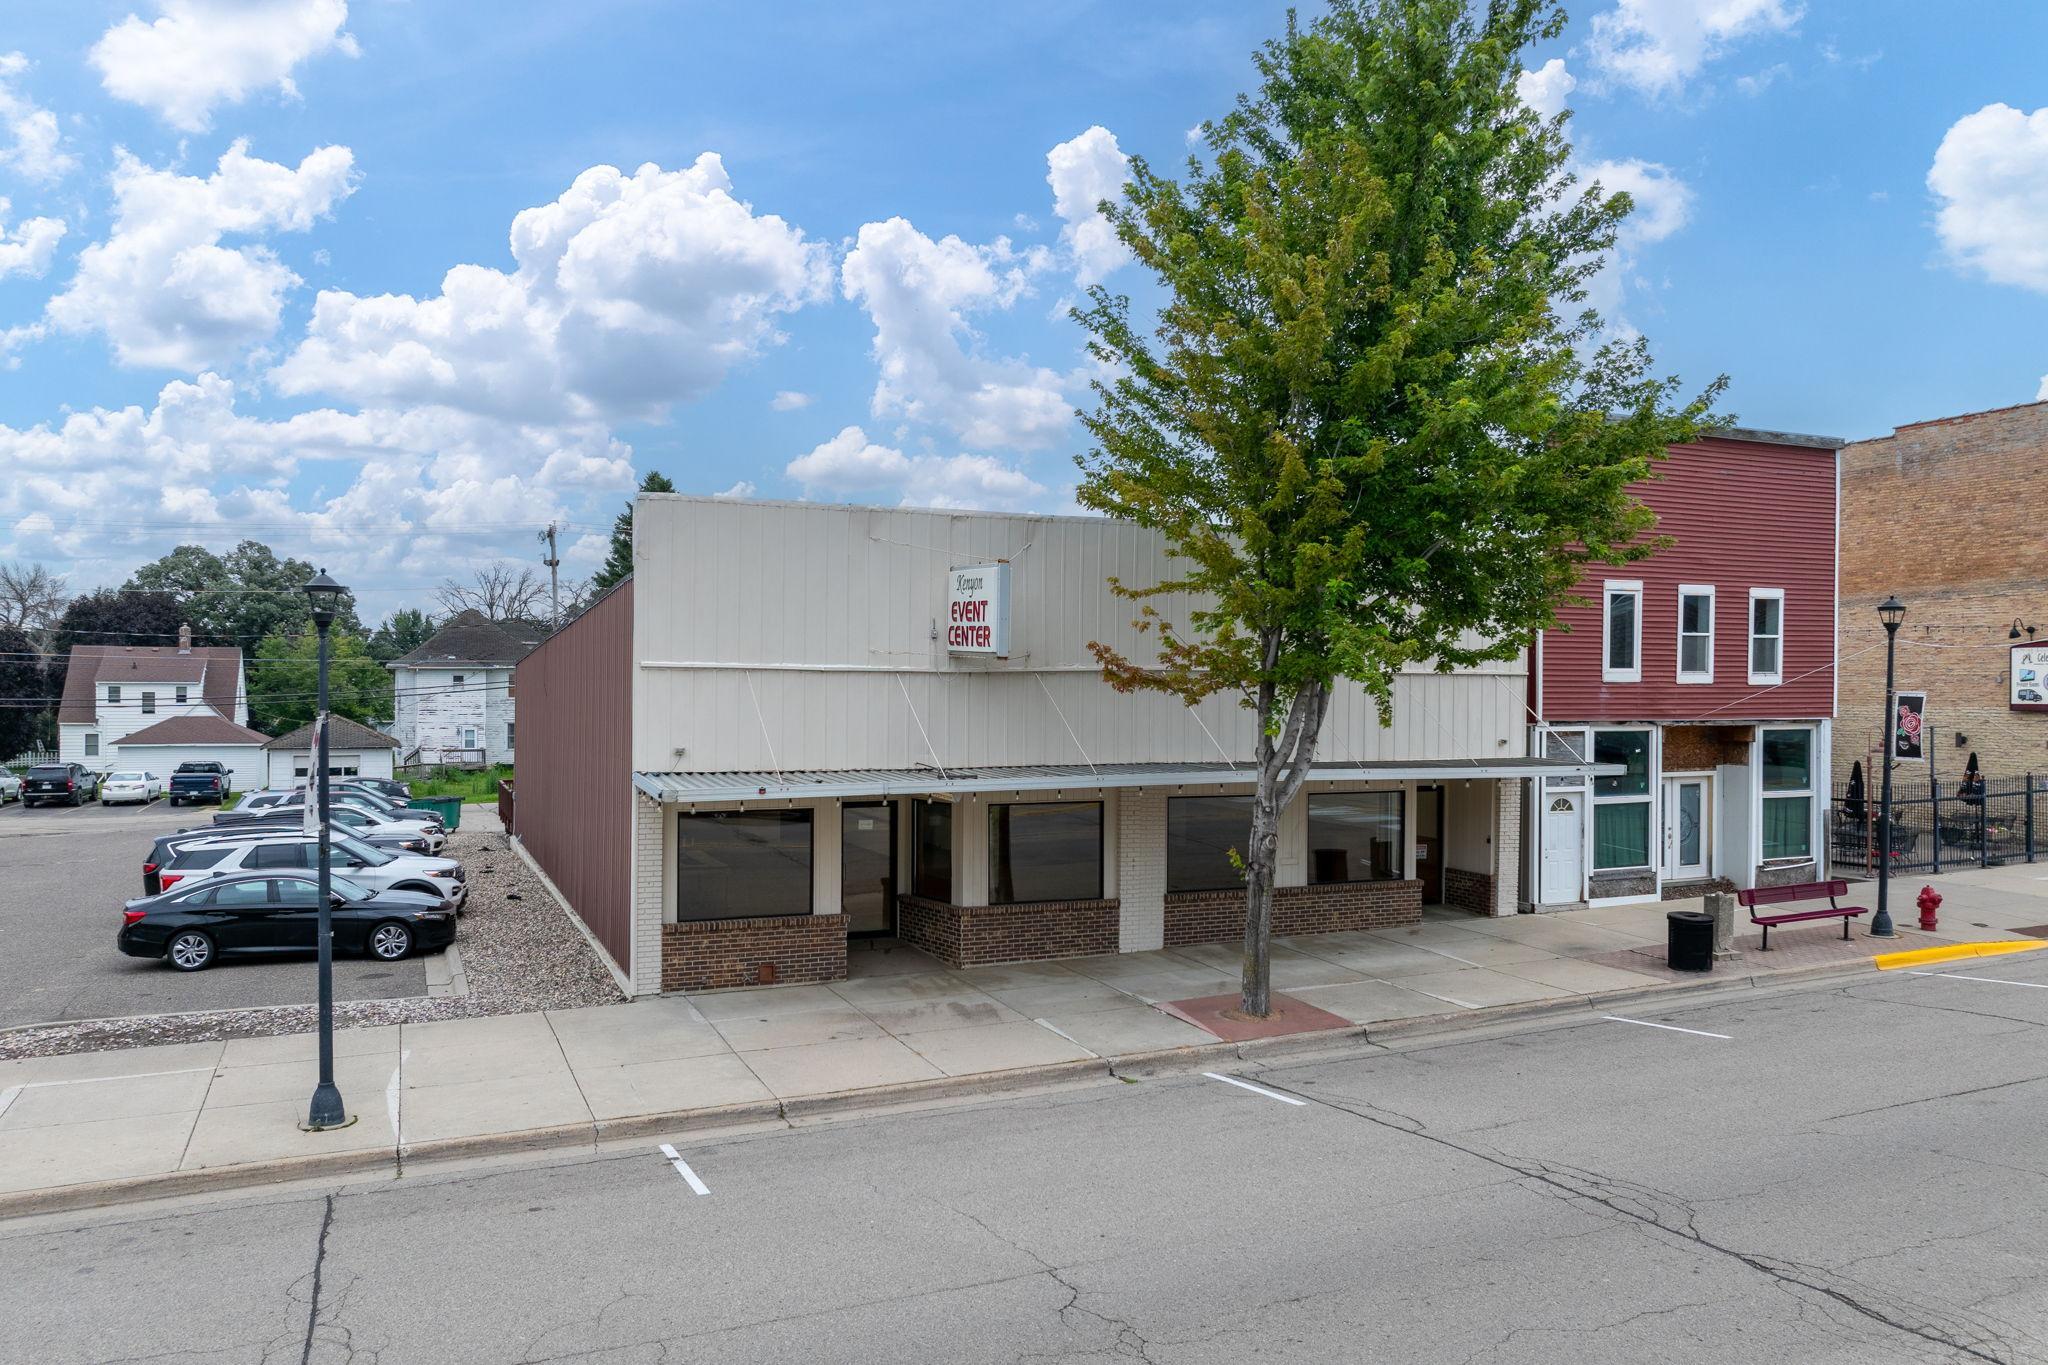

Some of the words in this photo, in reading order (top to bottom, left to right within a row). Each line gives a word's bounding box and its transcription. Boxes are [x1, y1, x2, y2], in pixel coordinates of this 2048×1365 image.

[956, 574, 983, 598] Kenyon
[951, 600, 988, 622] EVENT
[948, 626, 991, 647] CENTER
